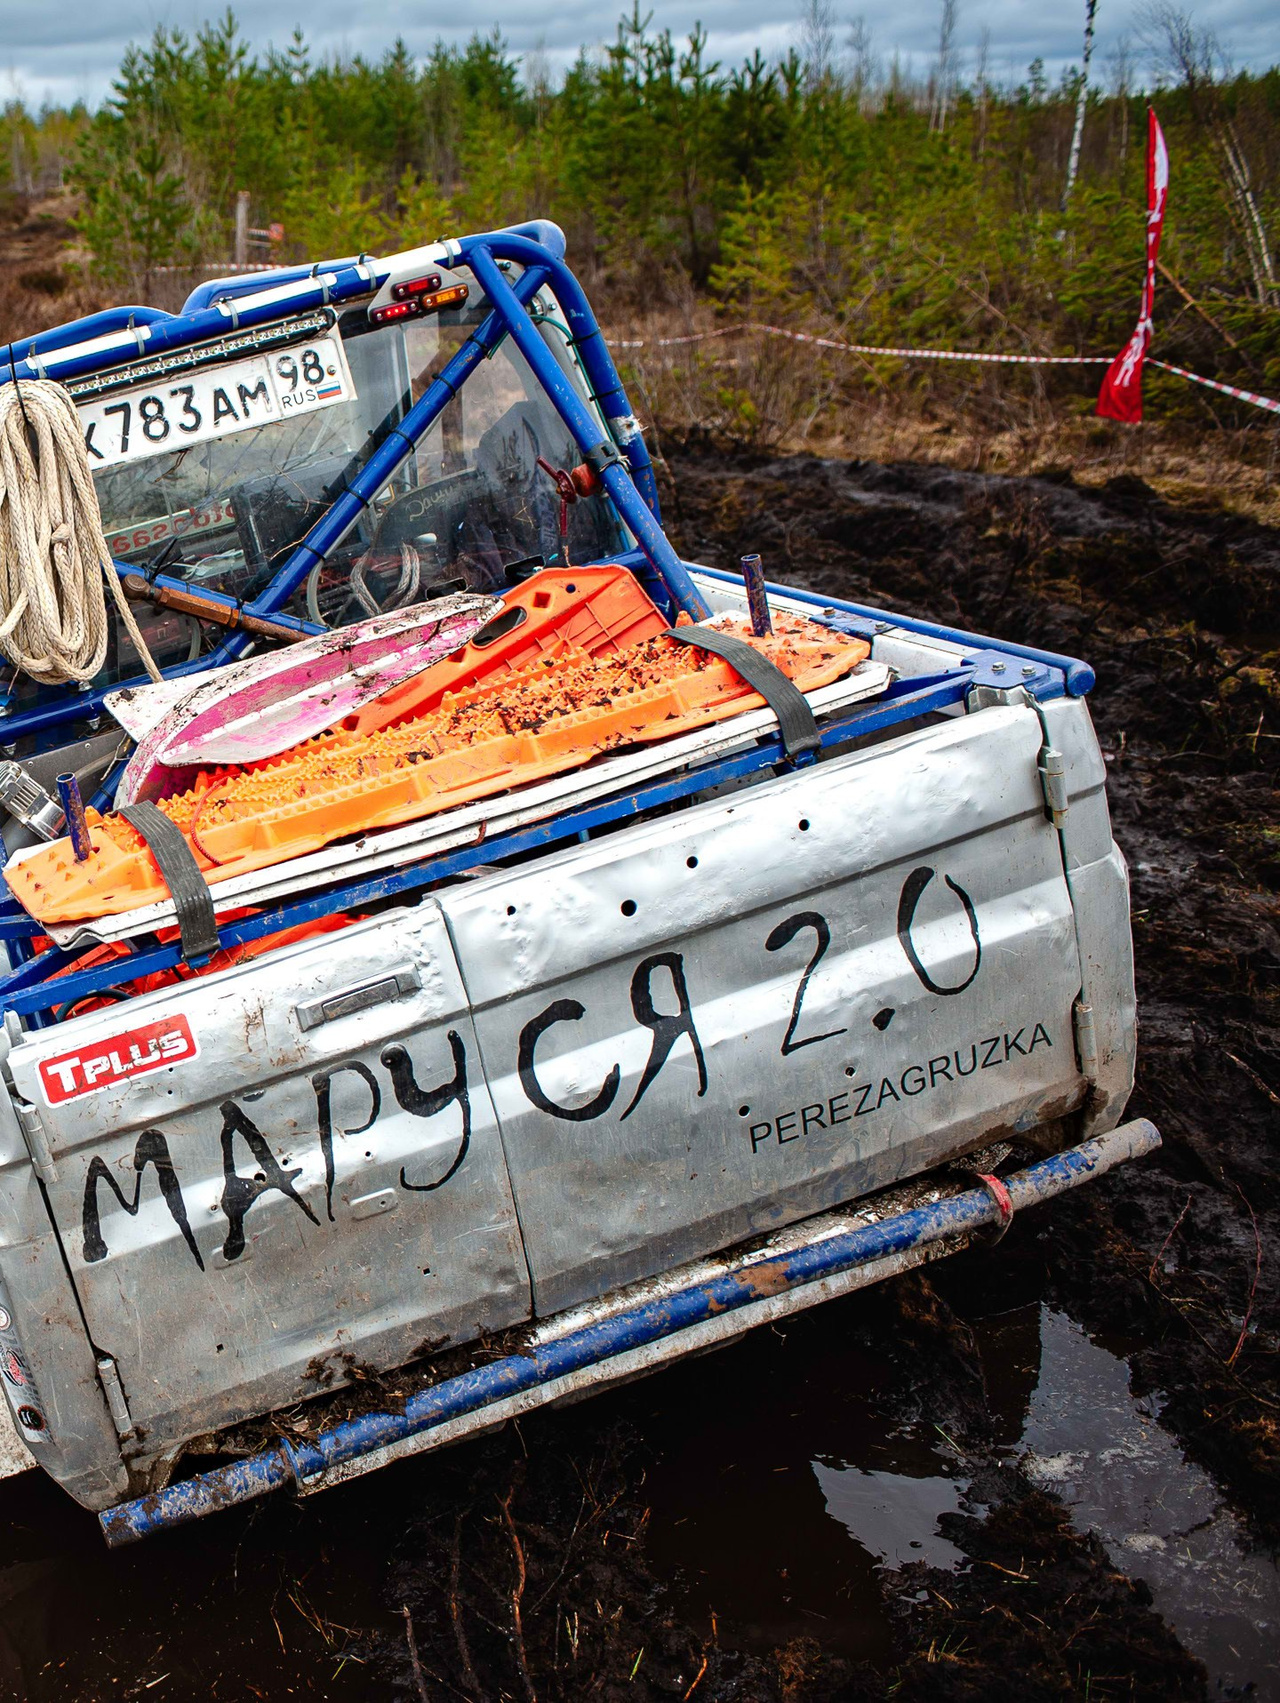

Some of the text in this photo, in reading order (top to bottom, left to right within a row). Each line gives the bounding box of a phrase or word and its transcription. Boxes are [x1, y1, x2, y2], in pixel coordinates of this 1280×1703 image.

[276, 349, 325, 392] 98
[281, 389, 317, 409] RUS
[765, 866, 982, 1056] 2.0
[46, 1030, 189, 1093] TPLUS
[749, 1023, 1053, 1154] PEREZAGRUZKA
